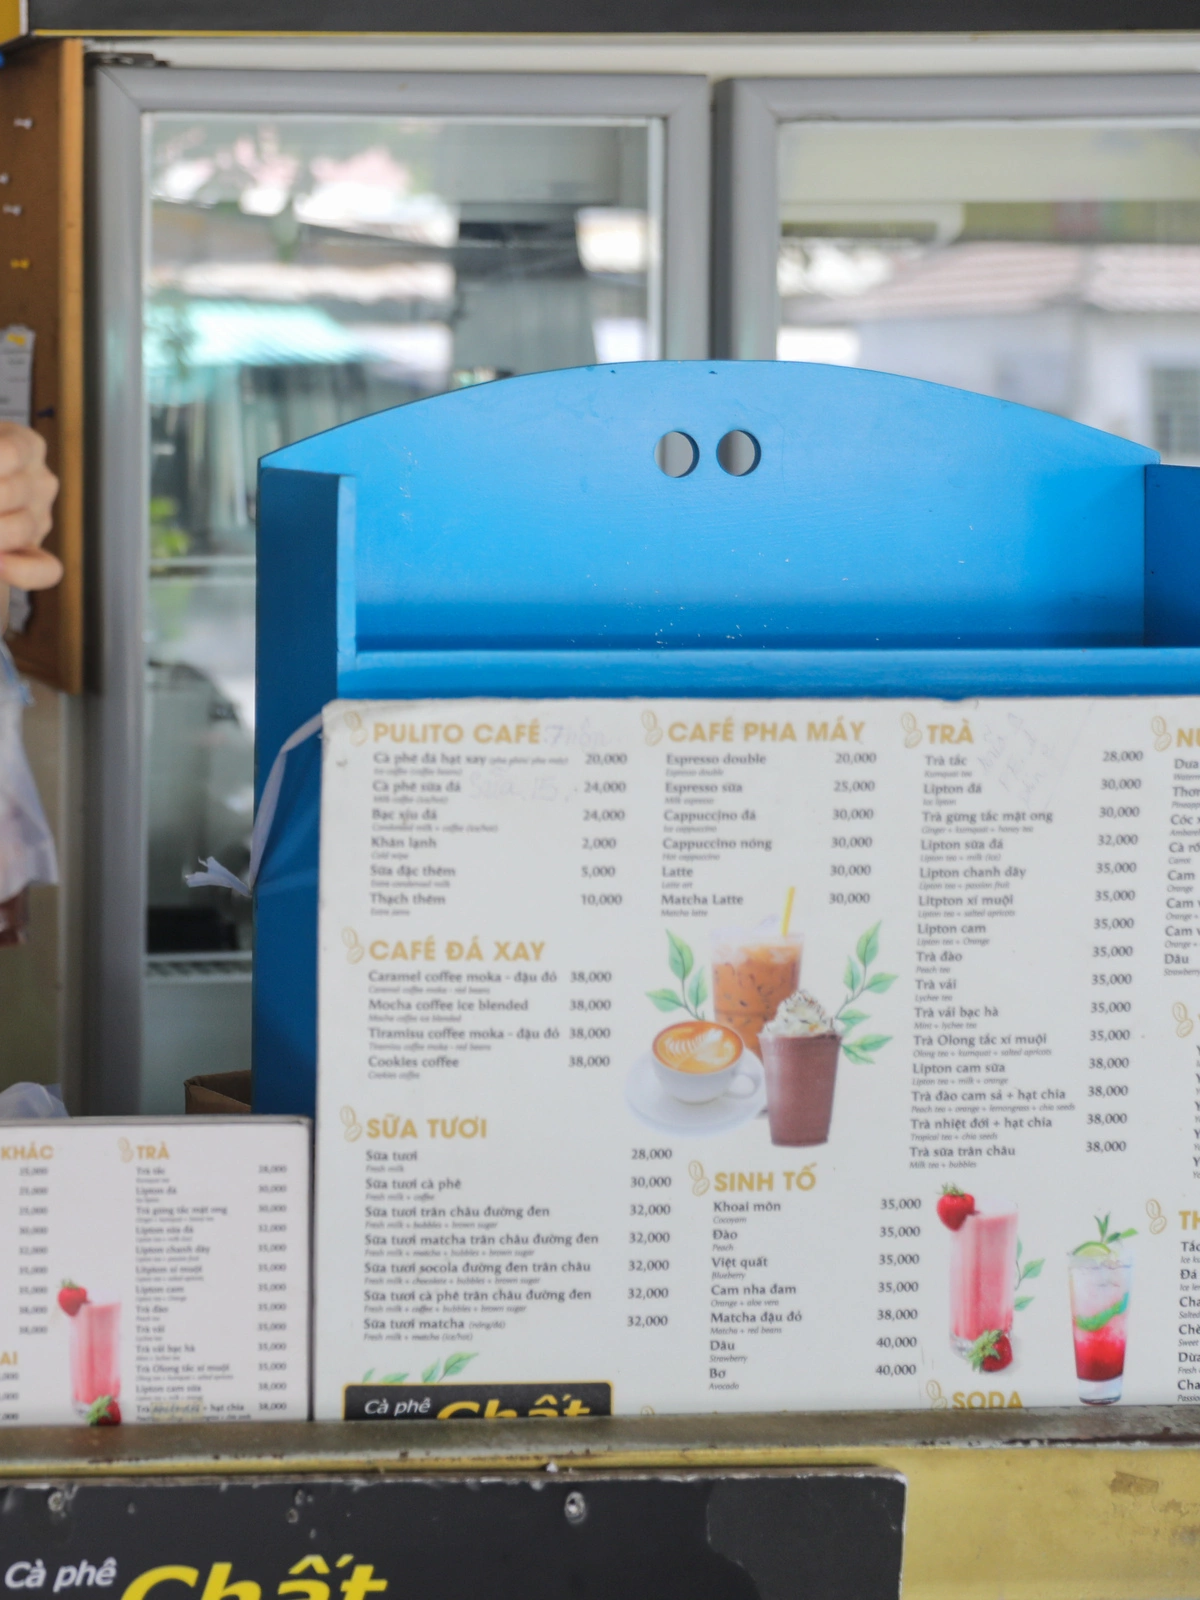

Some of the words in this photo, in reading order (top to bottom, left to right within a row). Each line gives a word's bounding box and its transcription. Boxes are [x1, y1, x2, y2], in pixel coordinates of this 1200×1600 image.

[373, 722, 464, 744] PULITO
[473, 719, 540, 744] CAFÉ
[667, 717, 734, 742] CAFÉ
[743, 721, 796, 742] PHA
[807, 716, 864, 741] MÁY
[928, 719, 973, 744] TRÀ
[666, 753, 721, 767] Espresso
[723, 753, 766, 764] double
[835, 752, 877, 764] 20,000
[925, 755, 945, 766] Trà
[1103, 750, 1144, 763] 28,000
[665, 781, 718, 795] Espresso
[834, 780, 875, 793] 25,000
[924, 784, 963, 798] Lipton
[967, 782, 982, 794] đá
[1101, 778, 1142, 791] 30,000
[664, 810, 738, 823] Cappuccino
[741, 809, 756, 821] đá
[833, 808, 874, 821] 30,000
[582, 837, 617, 850] 2,000
[662, 837, 737, 852] Cappuccino
[740, 838, 772, 852] nóng
[832, 836, 873, 848] 30,000
[662, 866, 693, 877] Latte
[831, 864, 871, 877] 30,000
[1167, 870, 1195, 881] Cam
[581, 893, 623, 906] 10,000
[661, 894, 708, 905] Matcha
[712, 894, 743, 905] Latte
[830, 892, 870, 905] 30,000
[917, 923, 957, 936] Lipton
[961, 925, 987, 934] cam
[1094, 917, 1135, 930] 35,000
[369, 936, 435, 961] CAFÉ
[446, 937, 483, 961] ĐÁ
[494, 942, 545, 961] XAY
[916, 951, 936, 962] Trà
[940, 951, 963, 962] đào
[1093, 946, 1133, 958] 35,000
[1164, 953, 1189, 964] Dâu
[915, 979, 935, 990] Trà
[1092, 973, 1132, 986] 35,000
[369, 999, 412, 1010] Mocha
[416, 998, 453, 1011] coffee
[457, 1000, 475, 1011] ice
[478, 999, 528, 1011] blended
[570, 999, 611, 1011] 38,000
[914, 1007, 934, 1018] Trà
[959, 1006, 980, 1020] bạc
[984, 1006, 999, 1017] hà
[1091, 1001, 1131, 1014] 35,000
[913, 1035, 933, 1046] Trà
[937, 1034, 975, 1048] Olong
[1090, 1029, 1130, 1042] 35,000
[368, 1056, 418, 1067] Cookies
[421, 1055, 459, 1068] coffee
[569, 1055, 610, 1068] 38,000
[913, 1063, 952, 1077] Lipton
[956, 1064, 981, 1074] cam
[1089, 1057, 1129, 1070] 38,000
[367, 1114, 418, 1139] SỮA
[427, 1117, 487, 1139] TƯƠI
[0, 1143, 53, 1160] KHÁC
[137, 1143, 169, 1159] TRÀ
[632, 1148, 672, 1161] 28,000
[909, 1146, 929, 1157] Trà
[986, 1145, 1015, 1156] châu
[1086, 1141, 1127, 1152] 38,000
[421, 1179, 434, 1189] cà
[438, 1177, 462, 1192] phê
[631, 1176, 672, 1188] 30,000
[714, 1172, 774, 1192] SINH
[784, 1163, 816, 1191] TỐ
[450, 1206, 480, 1217] châu
[527, 1205, 550, 1217] đen
[631, 1204, 671, 1217] 32,000
[714, 1201, 749, 1212] Khoai
[753, 1201, 781, 1211] môn
[881, 1198, 921, 1210] 35,000
[713, 1229, 738, 1240] Đào
[880, 1226, 921, 1238] 35,000
[711, 1257, 736, 1270] Việt
[740, 1256, 768, 1271] quất
[880, 1254, 920, 1266] 35,000
[711, 1285, 739, 1295] Cam
[743, 1284, 766, 1295] nha
[770, 1283, 796, 1294] đam
[879, 1281, 919, 1293] 35,000
[711, 1312, 757, 1323] Matcha
[760, 1311, 782, 1325] đậu
[878, 1309, 918, 1321] 38,000
[710, 1340, 735, 1351] Dâu
[876, 1336, 917, 1348] 40,000
[710, 1354, 748, 1364] Strawberry
[709, 1368, 726, 1378] Bơ
[876, 1364, 916, 1376] 40,000
[709, 1382, 739, 1390] Avocado
[364, 1399, 389, 1415] Cà
[393, 1397, 431, 1416] phê
[953, 1391, 1023, 1409] SODA
[4, 1559, 47, 1589] Cà
[52, 1557, 117, 1593] phê
